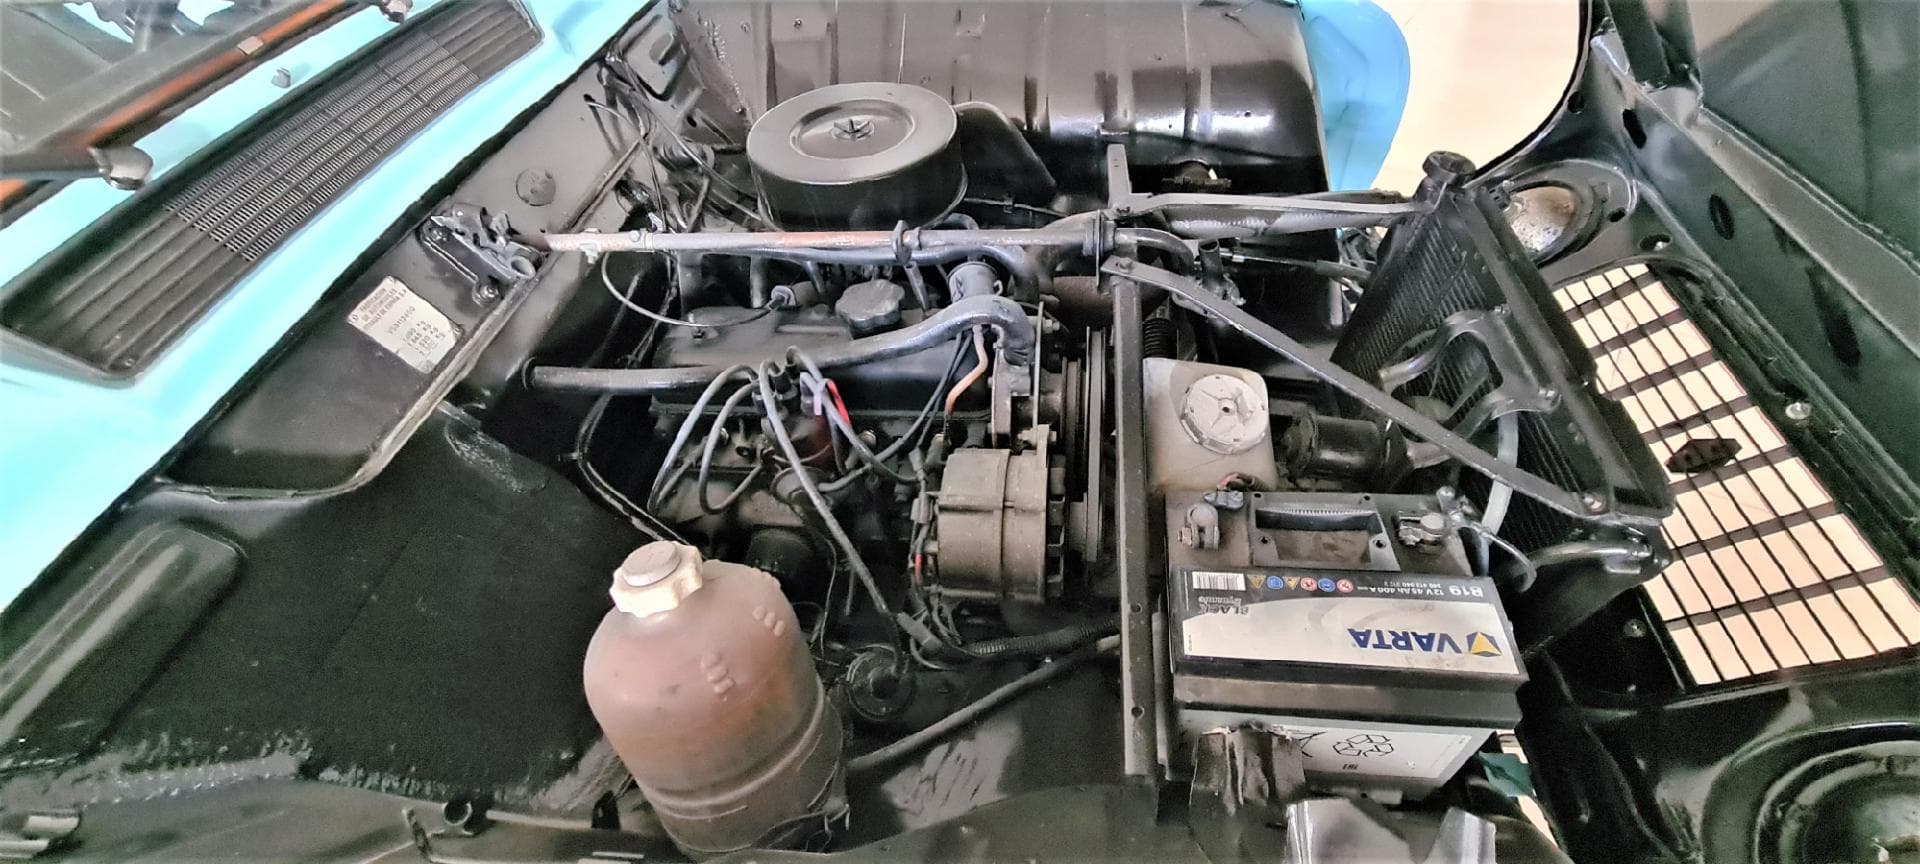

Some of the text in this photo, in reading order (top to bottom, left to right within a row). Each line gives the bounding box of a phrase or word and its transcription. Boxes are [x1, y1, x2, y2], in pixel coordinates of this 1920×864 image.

[1448, 584, 1484, 598] B19
[1198, 605, 1249, 616] BLACK
[1346, 627, 1463, 654] VARTA
